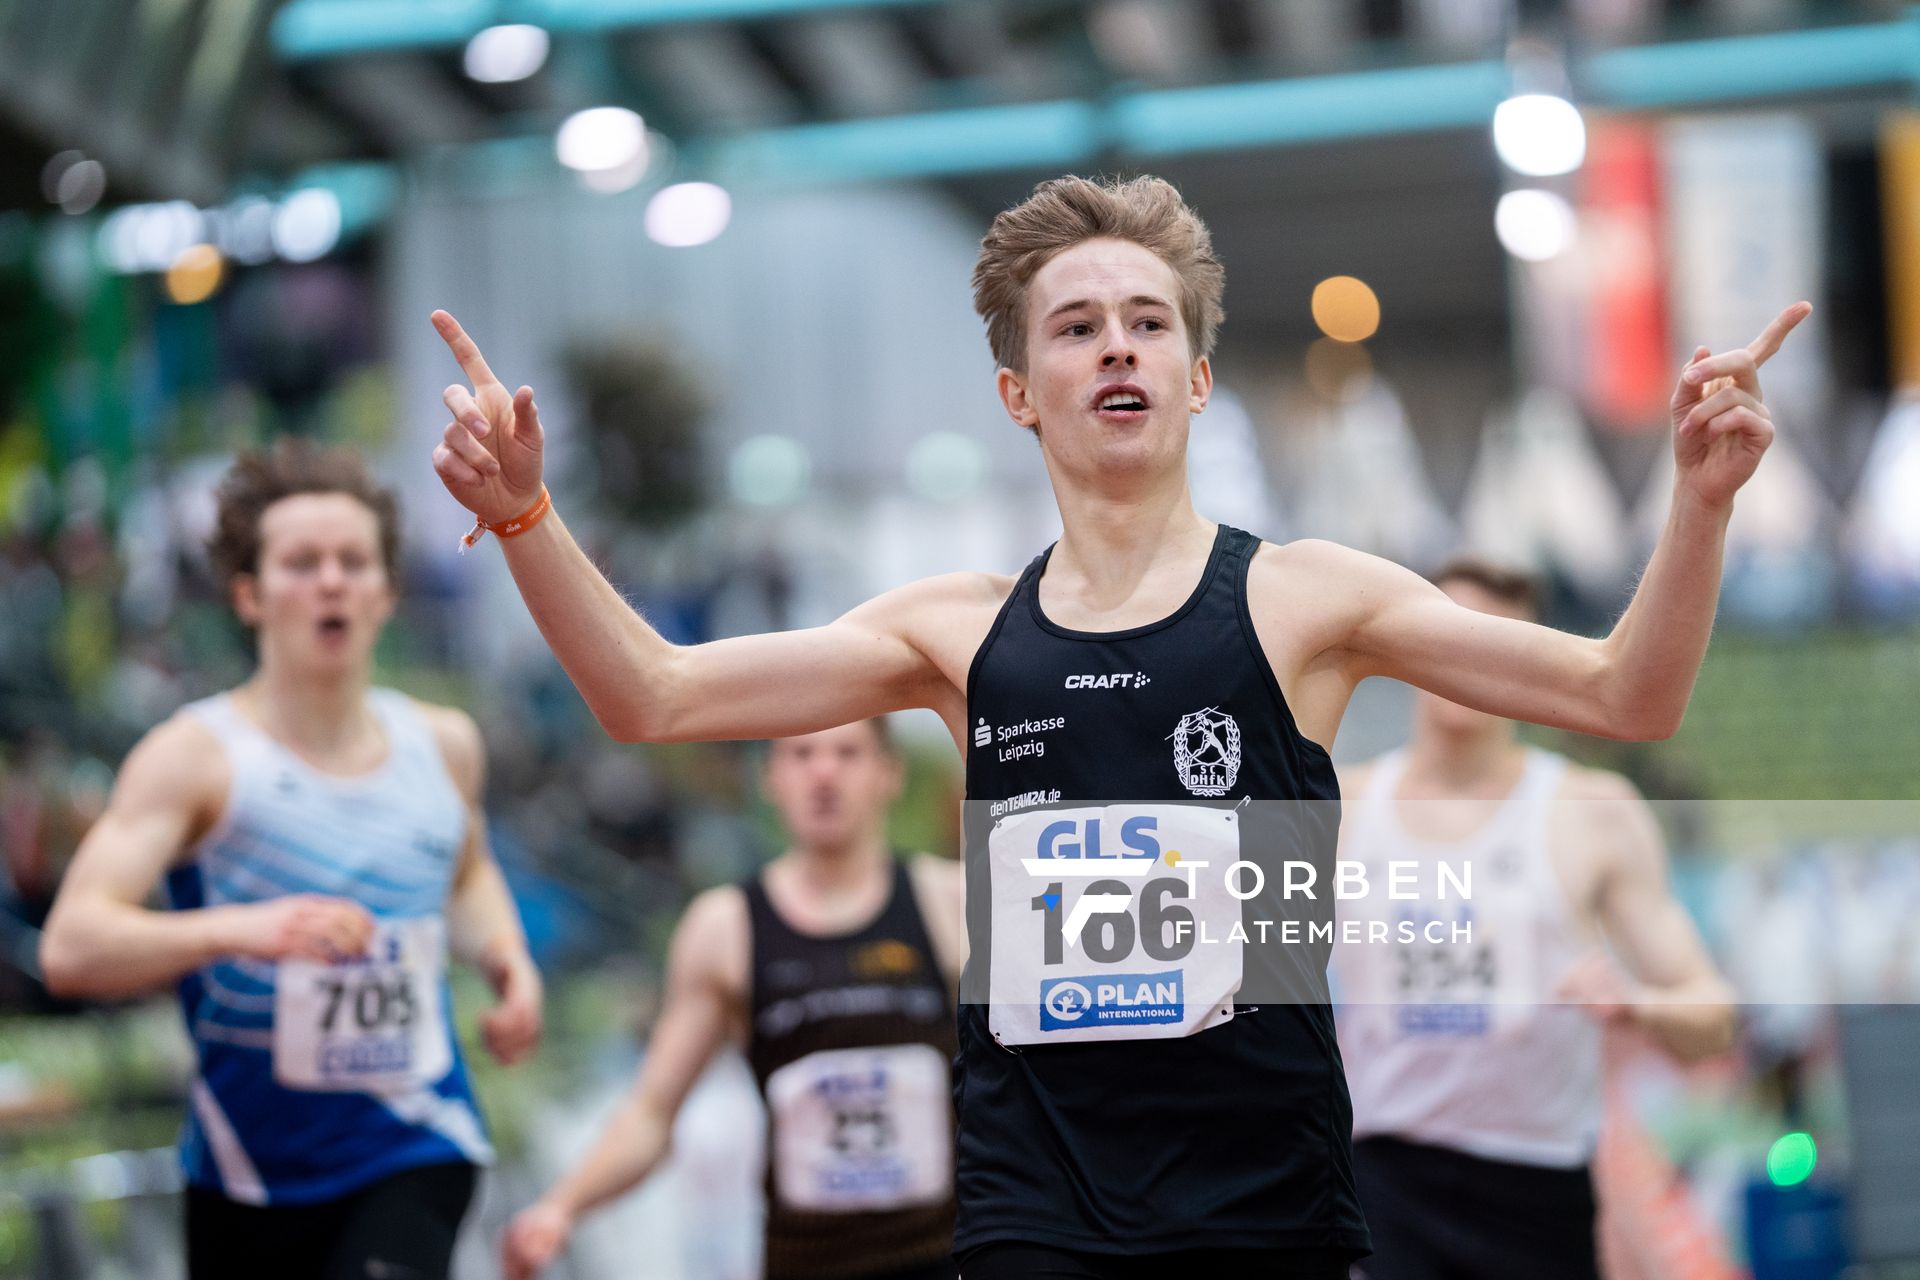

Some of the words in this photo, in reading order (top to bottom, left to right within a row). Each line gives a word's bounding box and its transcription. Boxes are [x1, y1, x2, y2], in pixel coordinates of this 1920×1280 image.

[1065, 673, 1134, 689] CRAFT
[997, 716, 1065, 743] Sparkasse
[998, 739, 1045, 763] Leipzig
[1097, 982, 1177, 1006] PLAN
[1098, 1008, 1177, 1019] INTERNATIONAL
